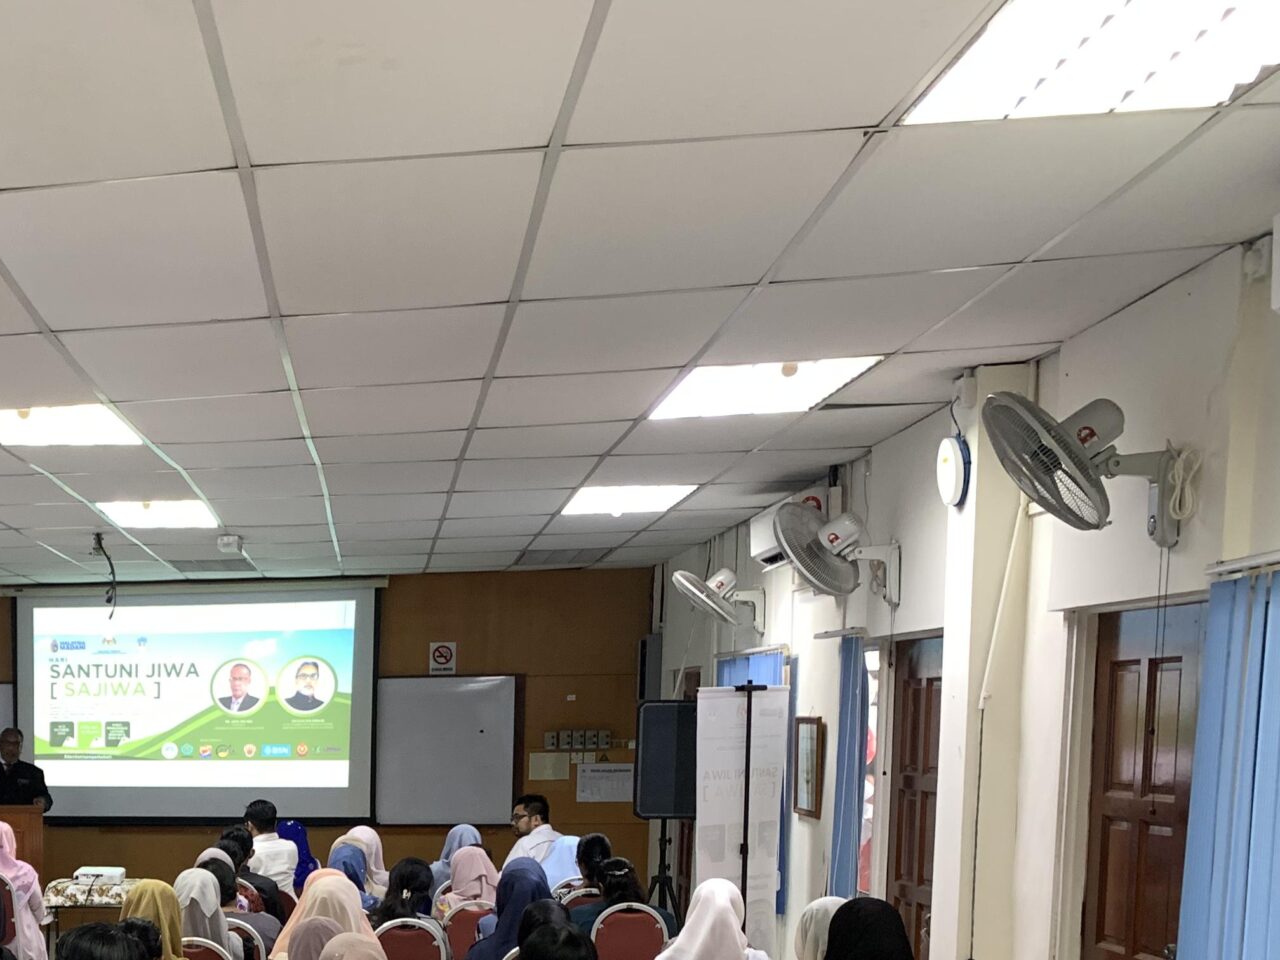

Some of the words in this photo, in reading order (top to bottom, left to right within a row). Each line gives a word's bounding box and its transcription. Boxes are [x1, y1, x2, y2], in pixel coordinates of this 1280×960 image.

[50, 663, 139, 679] SANTUNI
[146, 663, 199, 678] JIWA
[64, 681, 147, 697] SAJIWA
